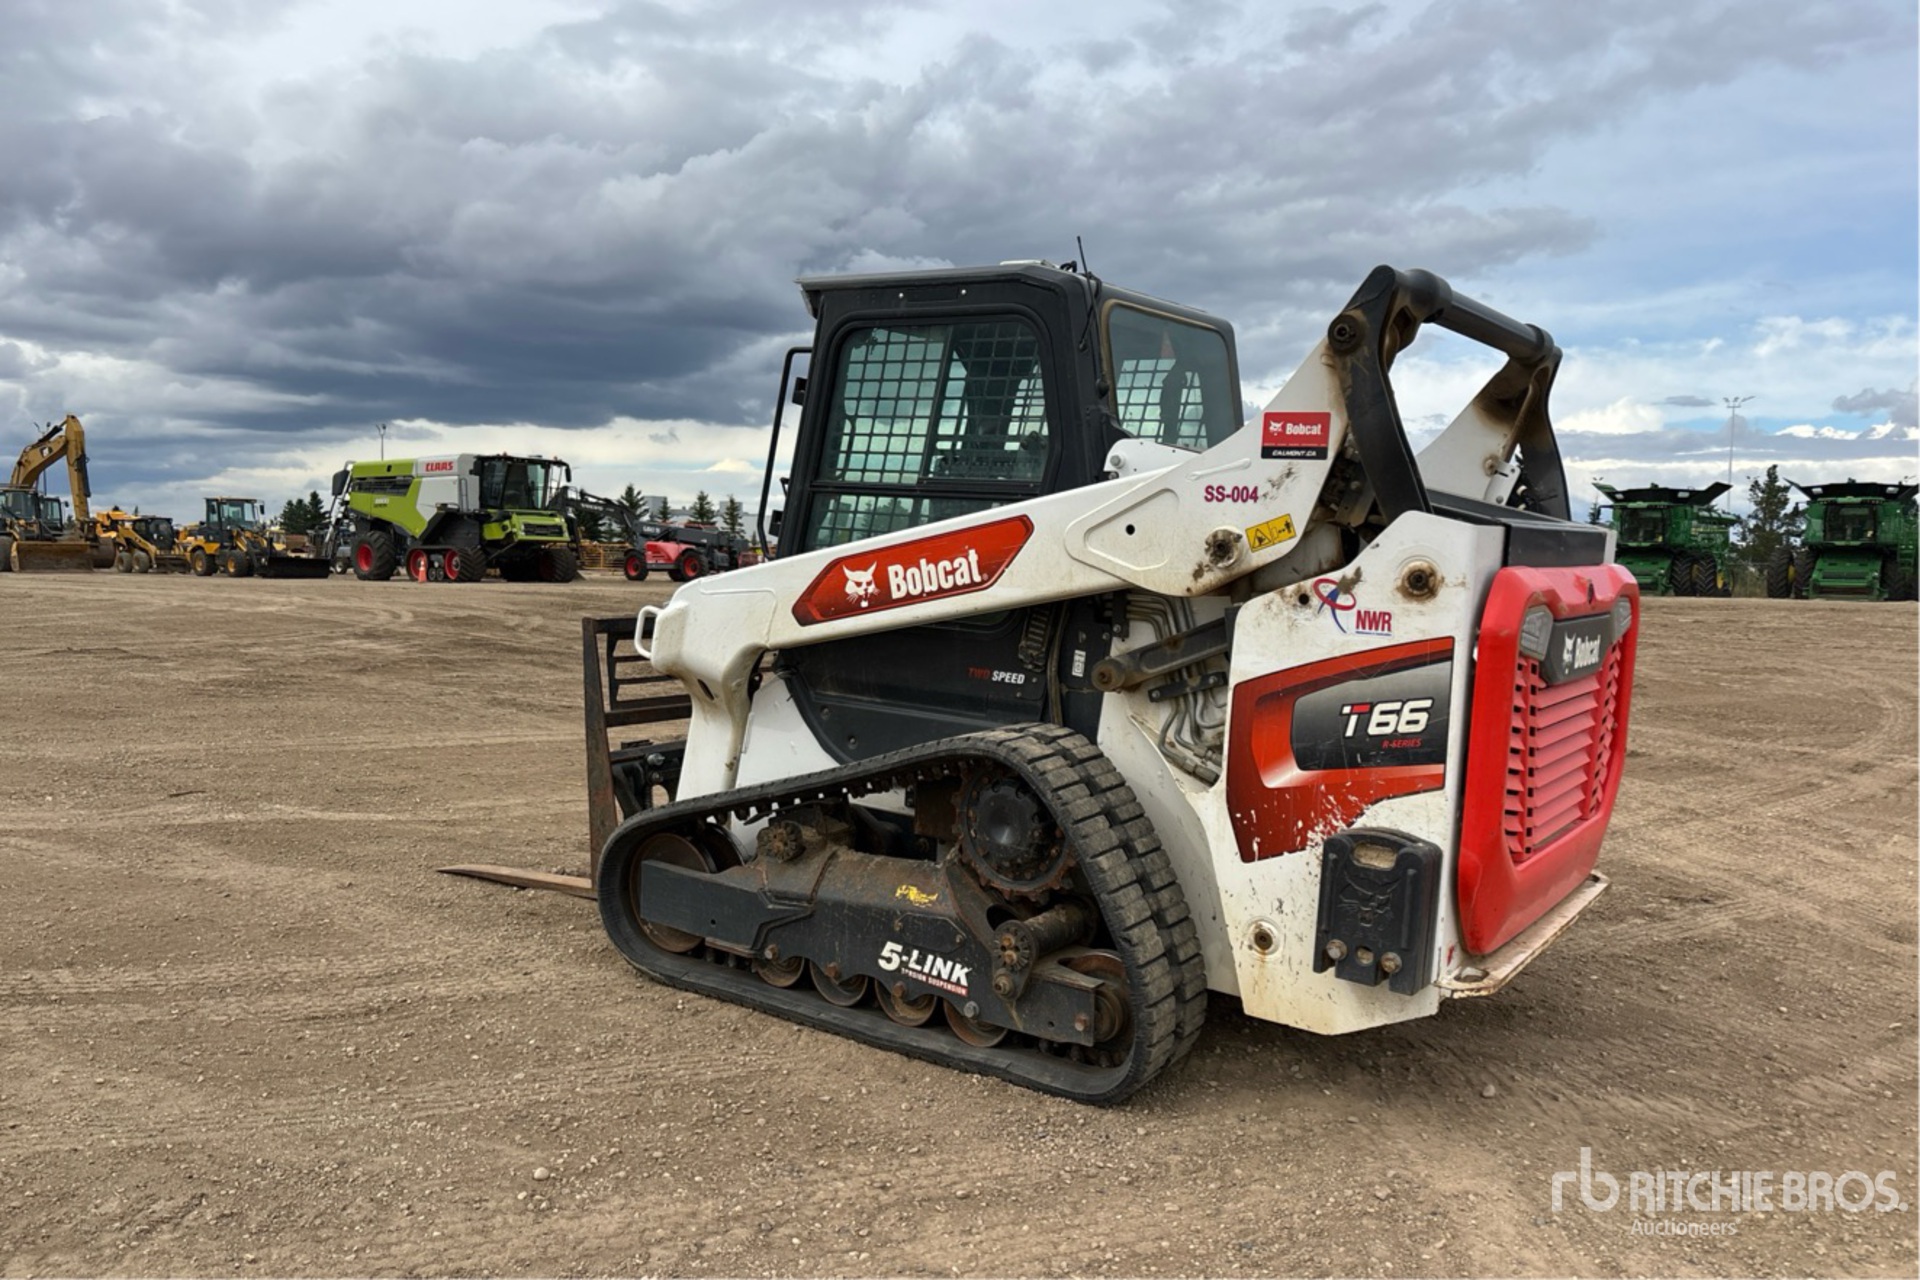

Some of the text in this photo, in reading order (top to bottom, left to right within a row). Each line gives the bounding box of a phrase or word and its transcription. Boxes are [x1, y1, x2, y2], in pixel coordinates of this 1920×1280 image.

[1285, 422, 1322, 435] Bobcat
[425, 461, 454, 472] CLAAS
[1204, 485, 1259, 504] SS-004
[887, 548, 982, 600] Bobcat
[1356, 609, 1393, 632] NWR
[1573, 634, 1602, 669] Bobcat
[967, 666, 1026, 685] TWO SPEED
[1341, 698, 1434, 738] T66
[1381, 737, 1423, 750] R-SERIES
[877, 940, 973, 987] 5-LINK
